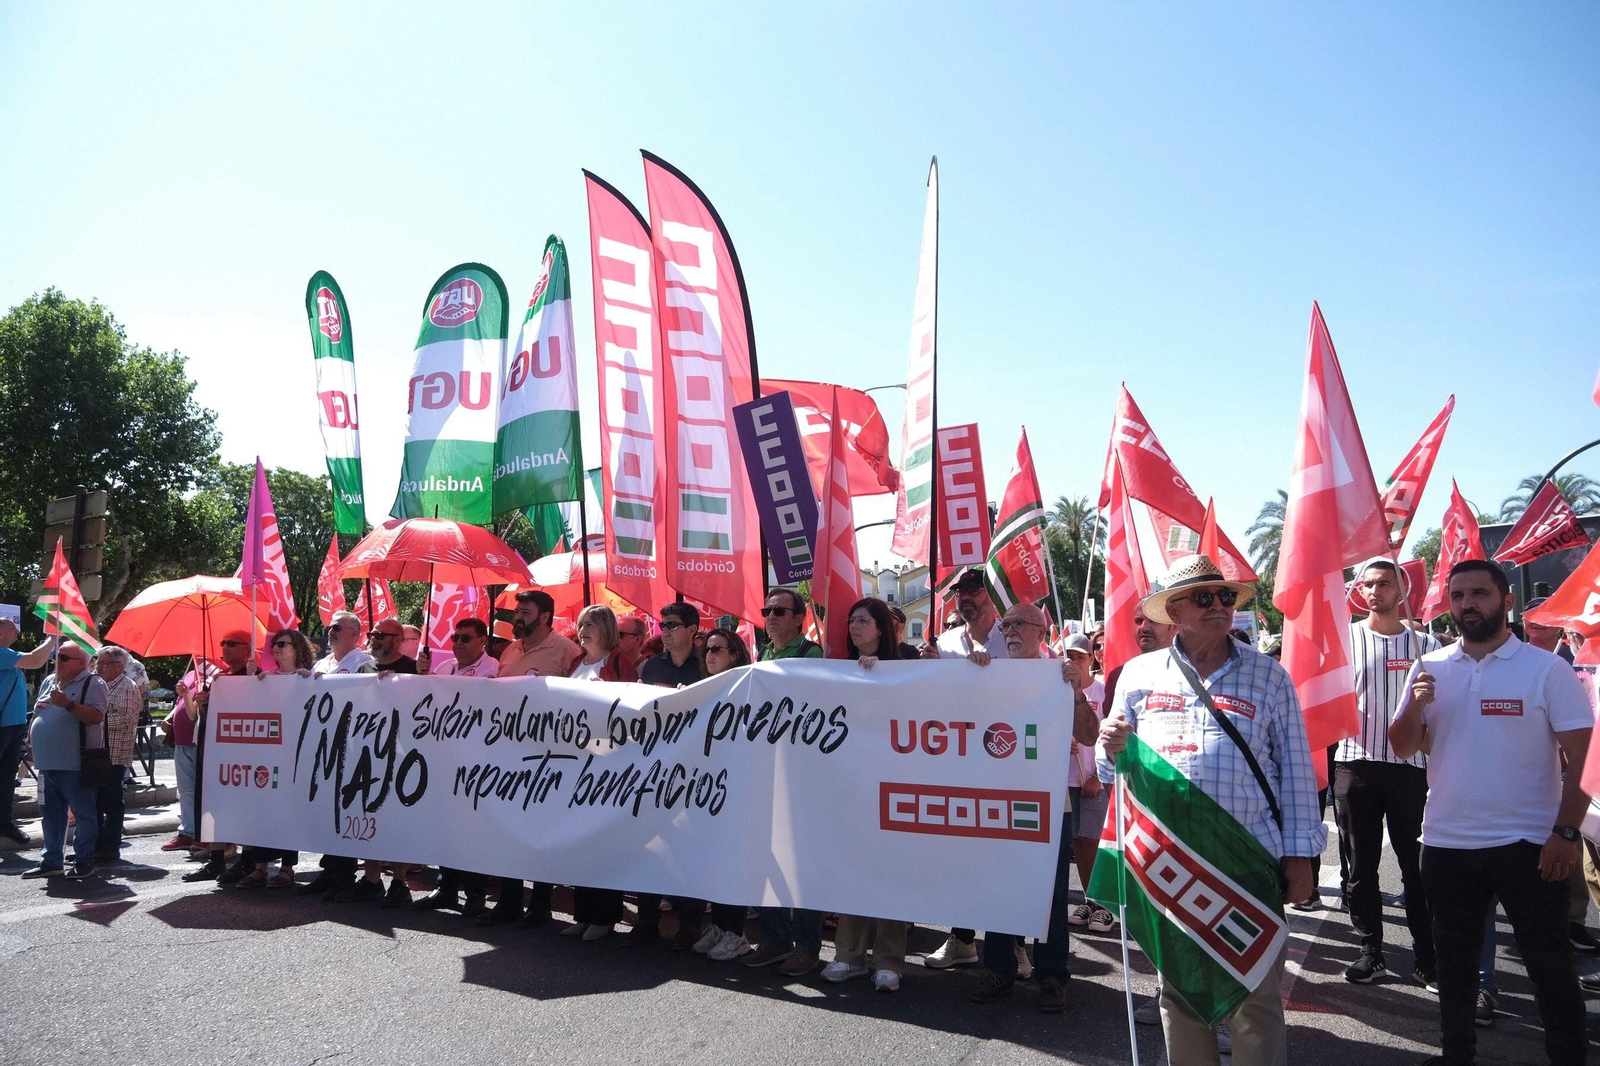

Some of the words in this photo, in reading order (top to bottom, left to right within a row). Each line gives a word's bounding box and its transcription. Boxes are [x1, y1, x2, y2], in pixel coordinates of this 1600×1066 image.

[750, 403, 805, 535] CCOO
[937, 426, 981, 566] CCOO
[788, 566, 814, 579] Córdo
[1012, 536, 1041, 585] órdoba
[220, 719, 269, 738] CCOO
[412, 692, 483, 742] Subir
[607, 698, 699, 757] bajar
[704, 696, 849, 757] precios
[890, 719, 976, 757] UGT
[219, 763, 252, 788] UGT
[453, 750, 579, 811] repartir
[568, 754, 728, 817] beneficios
[342, 815, 377, 842] 2023
[888, 792, 1009, 829] CCOO
